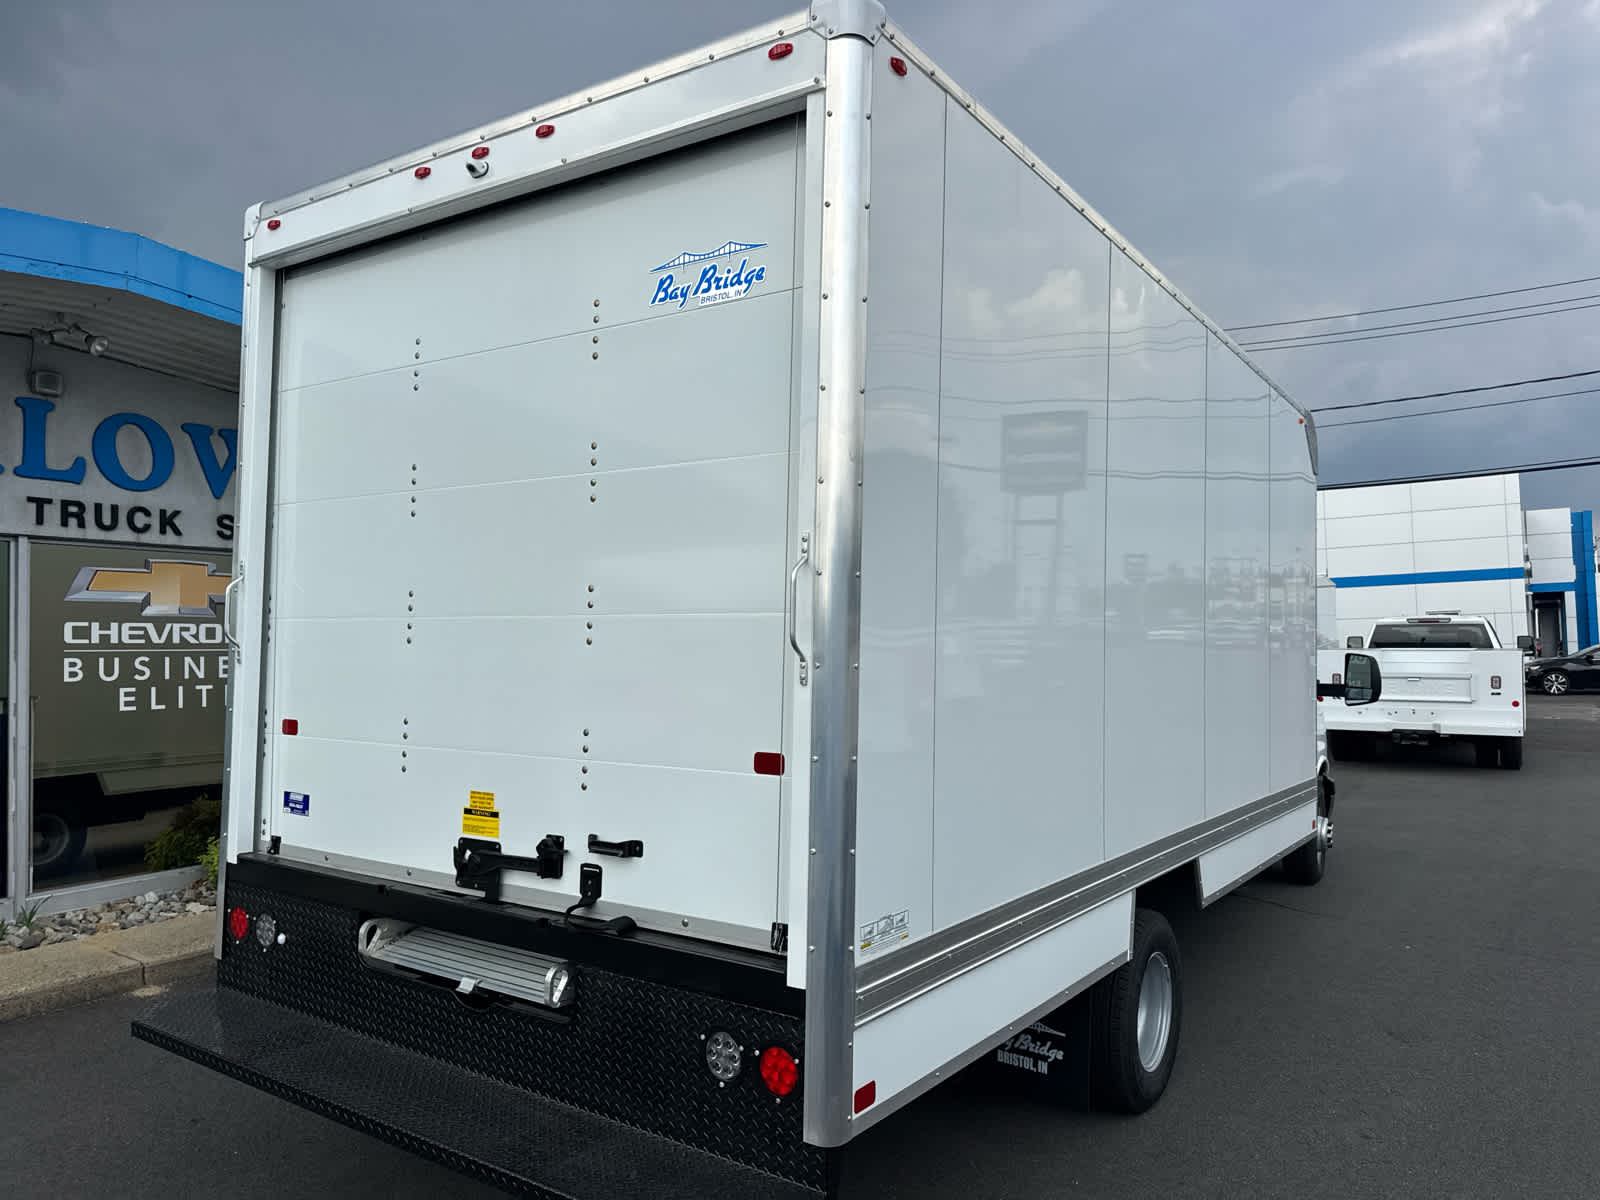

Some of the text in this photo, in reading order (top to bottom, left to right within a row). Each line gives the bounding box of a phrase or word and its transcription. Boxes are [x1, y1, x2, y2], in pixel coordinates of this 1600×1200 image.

[650, 258, 766, 308] Bay Bridge
[0, 396, 239, 500] LOW
[26, 496, 183, 537] TRUCK
[63, 621, 230, 645] CHEVRO
[118, 684, 228, 713] ELIT
[1014, 1033, 1064, 1063] Bridge
